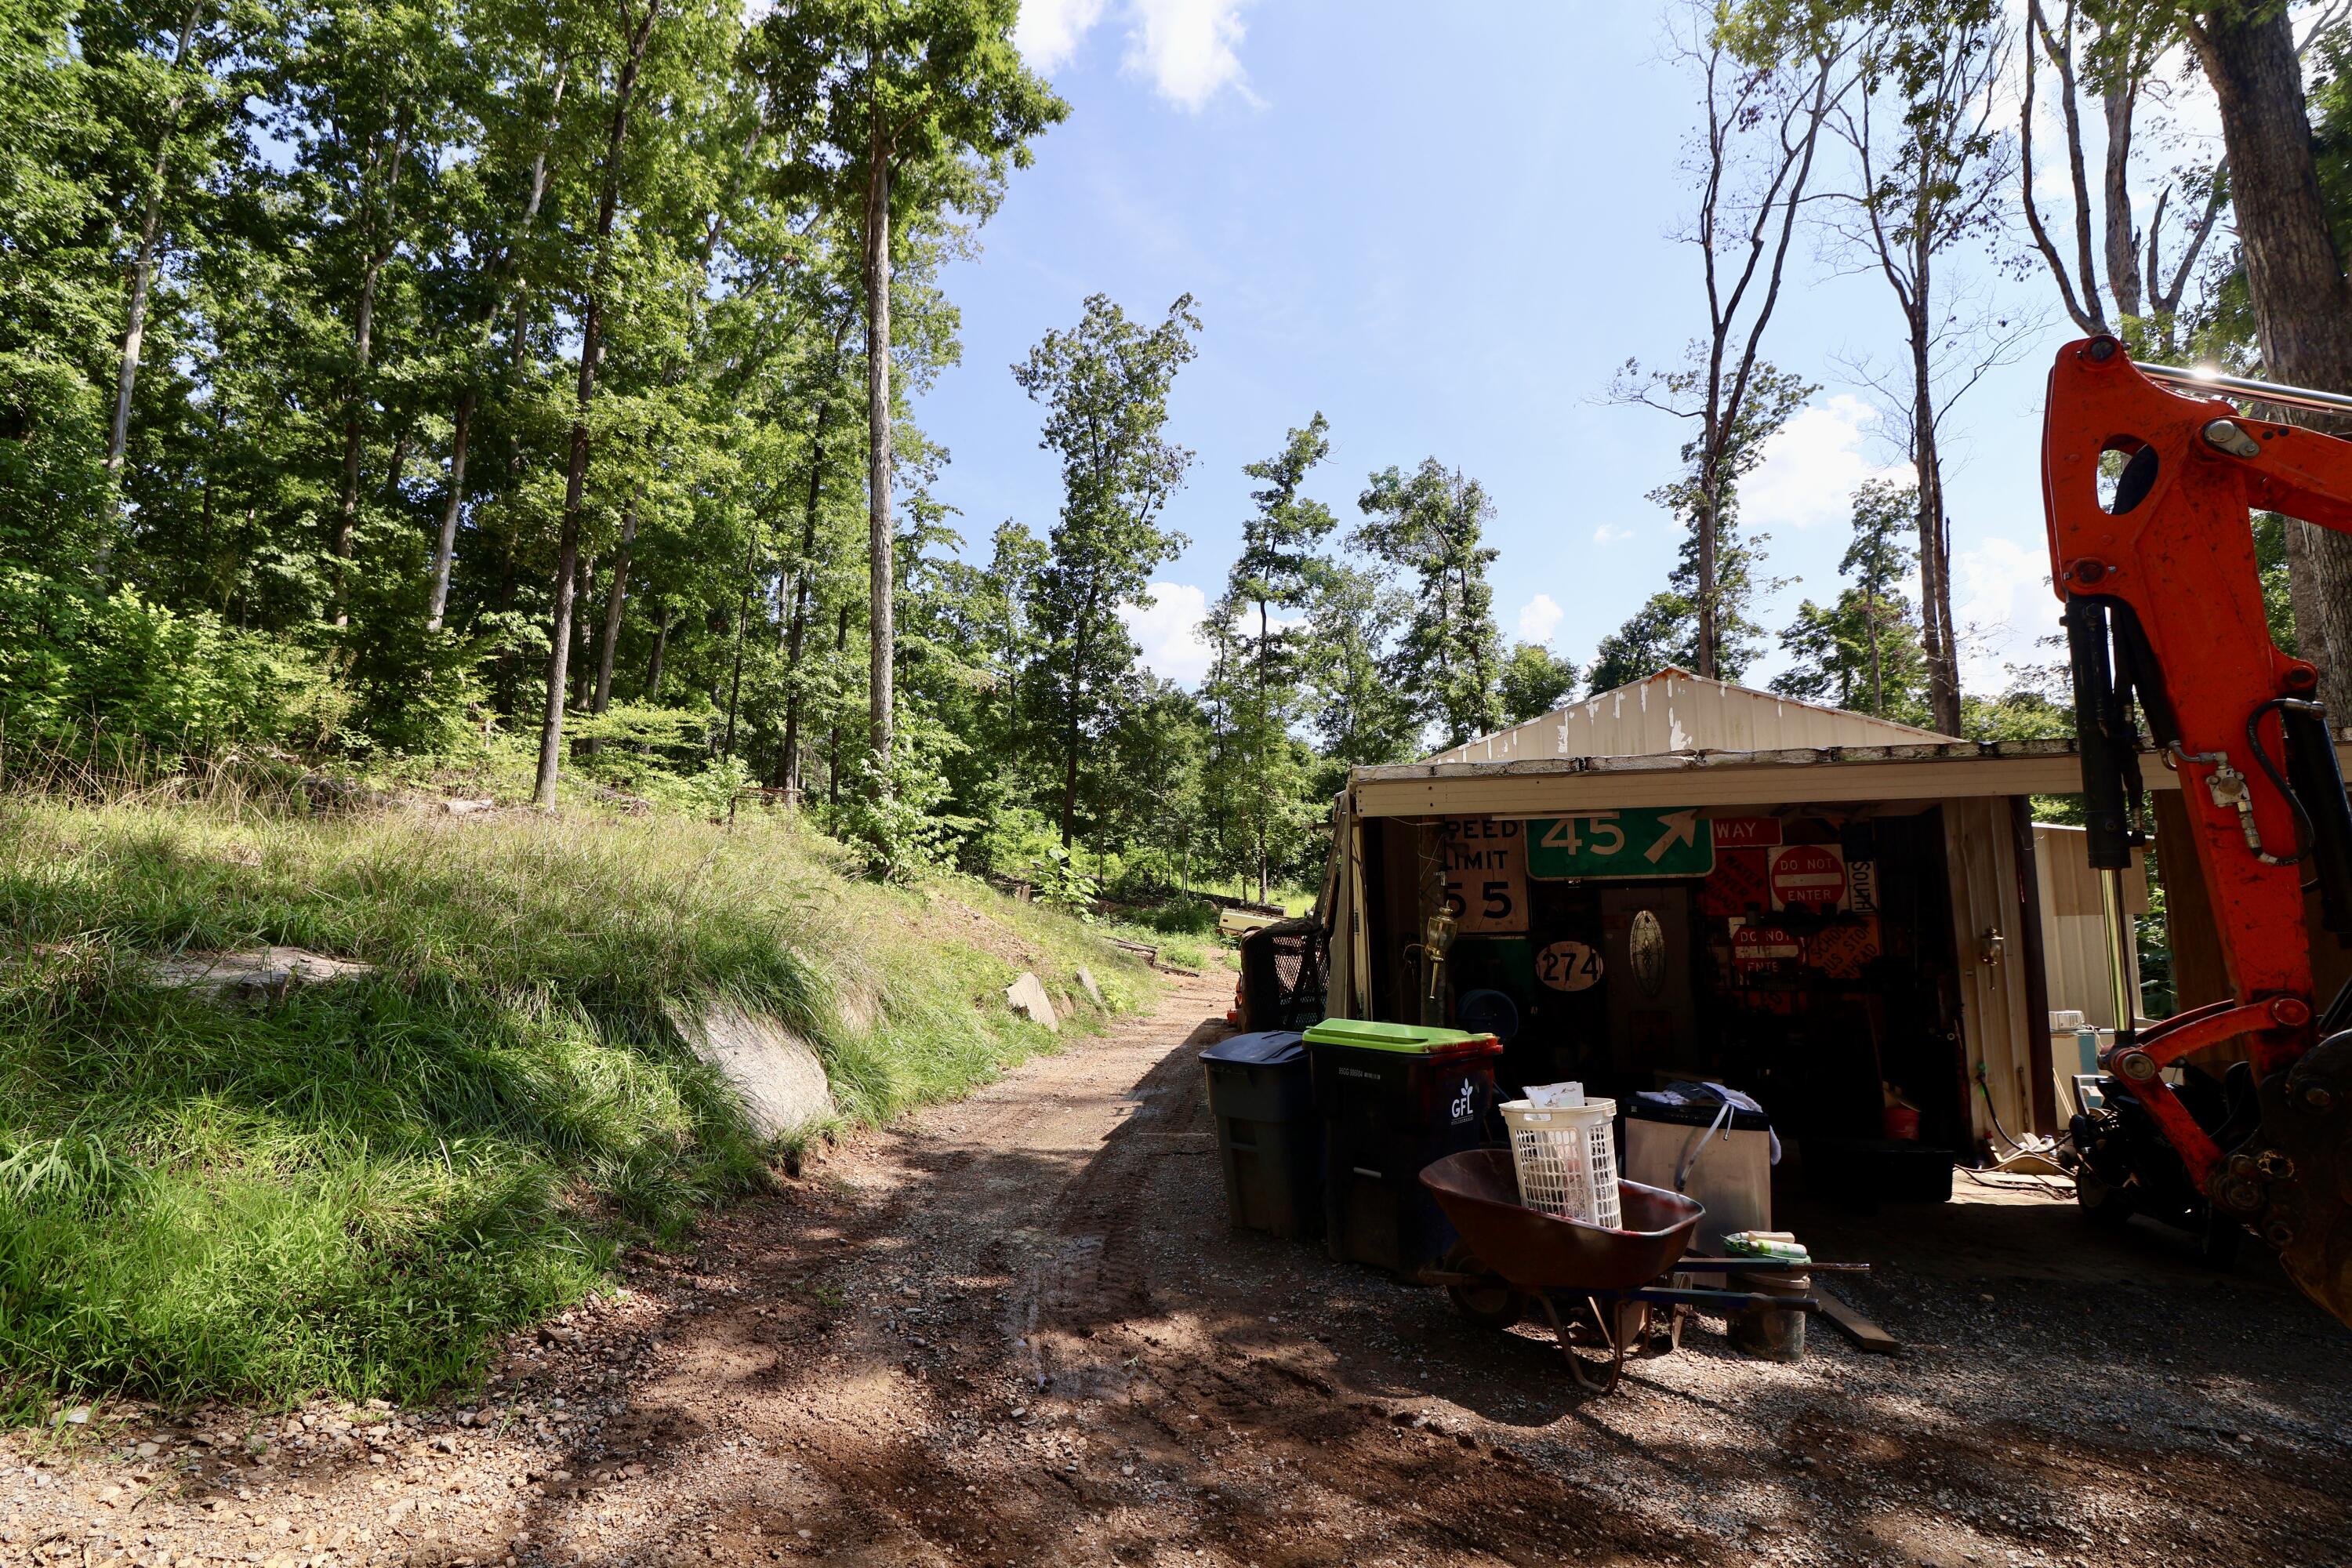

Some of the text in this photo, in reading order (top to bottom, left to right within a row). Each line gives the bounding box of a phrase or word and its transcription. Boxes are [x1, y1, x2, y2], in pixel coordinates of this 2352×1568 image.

[1446, 820, 1518, 838] PEED
[1541, 818, 1625, 856] 45
[1715, 822, 1756, 839] WAY
[1780, 858, 1832, 871] DO NOT
[1446, 881, 1512, 918] 55
[1788, 890, 1831, 902] ENTER
[1740, 931, 1756, 942] DO
[1810, 927, 1848, 959] SCHOO
[1542, 953, 1599, 981] 274
[1748, 961, 1780, 972] ENTE
[1452, 1091, 1473, 1118] GFL
